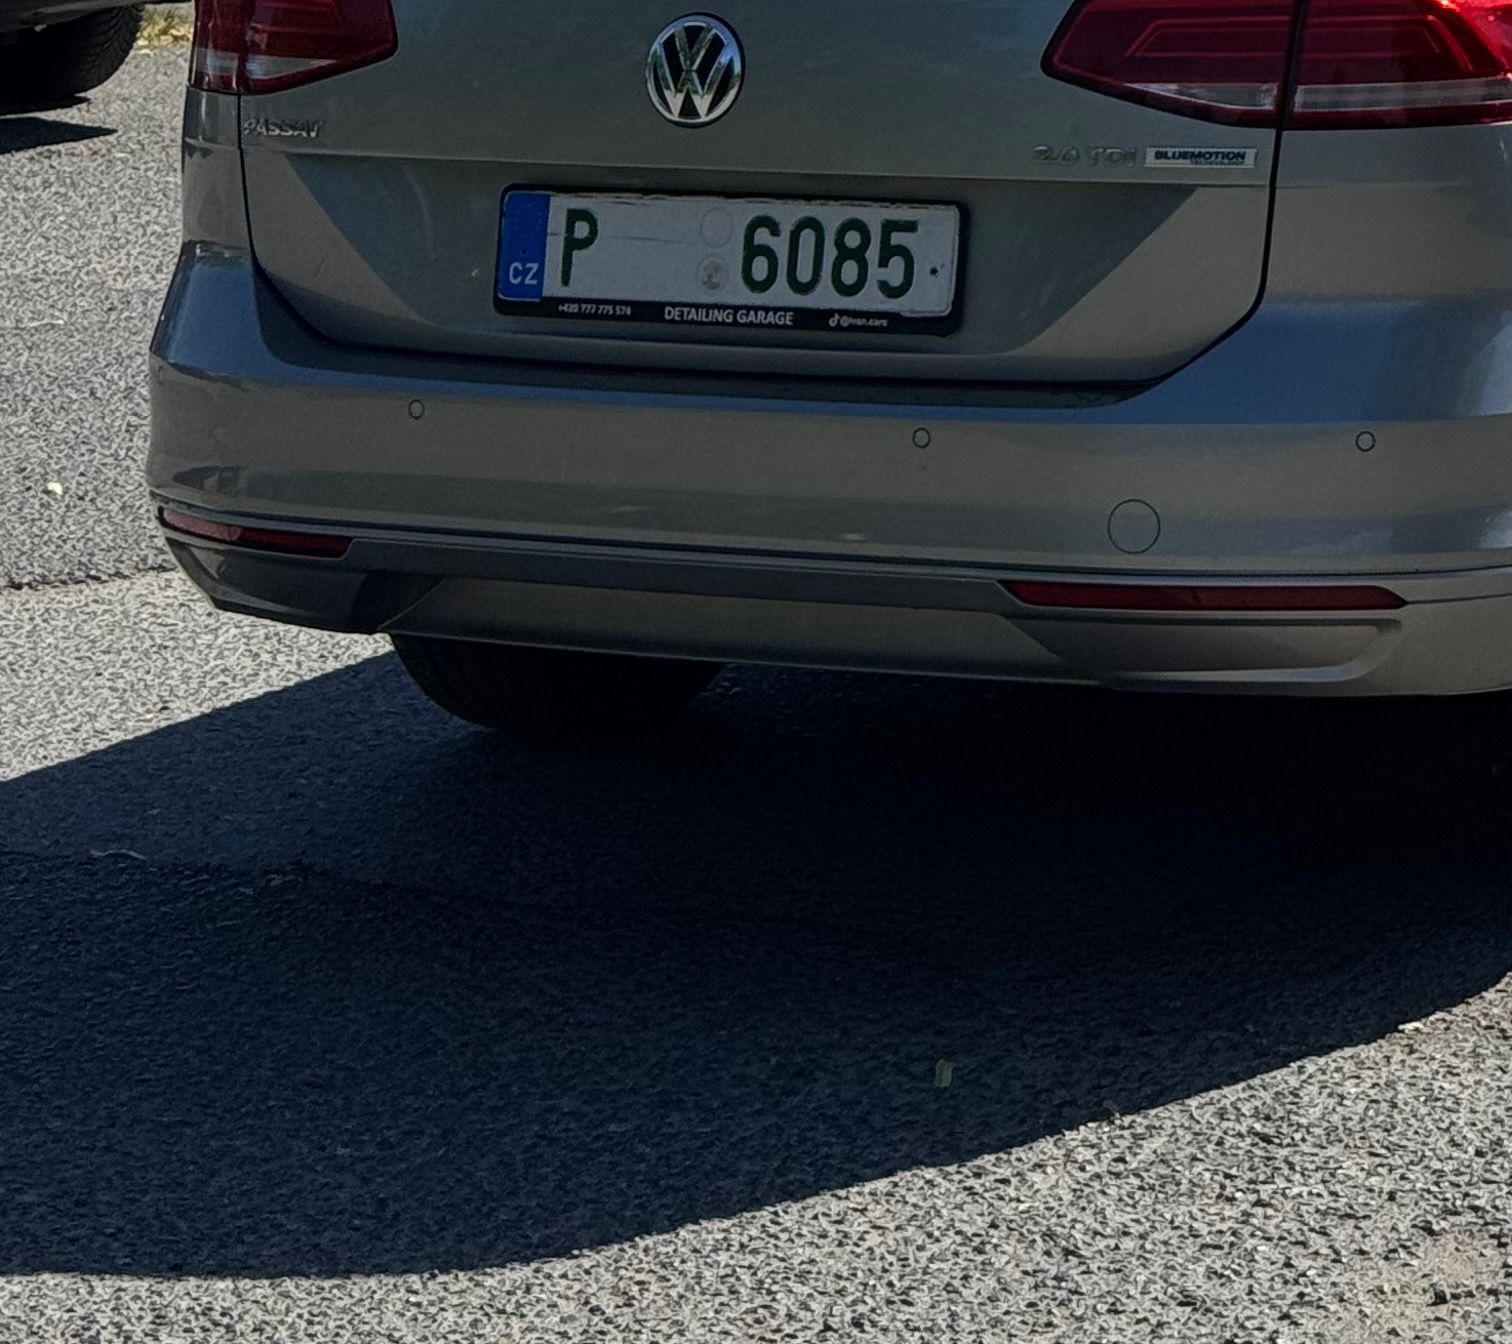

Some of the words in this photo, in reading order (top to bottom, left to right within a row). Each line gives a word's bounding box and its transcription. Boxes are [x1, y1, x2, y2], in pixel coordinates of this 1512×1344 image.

[1154, 150, 1246, 161] BLUEMOTION
[561, 207, 599, 288] P
[740, 215, 919, 299] 6085
[509, 262, 539, 285] CZ
[664, 306, 733, 323] DETAILING
[736, 310, 794, 326] GARAGE
